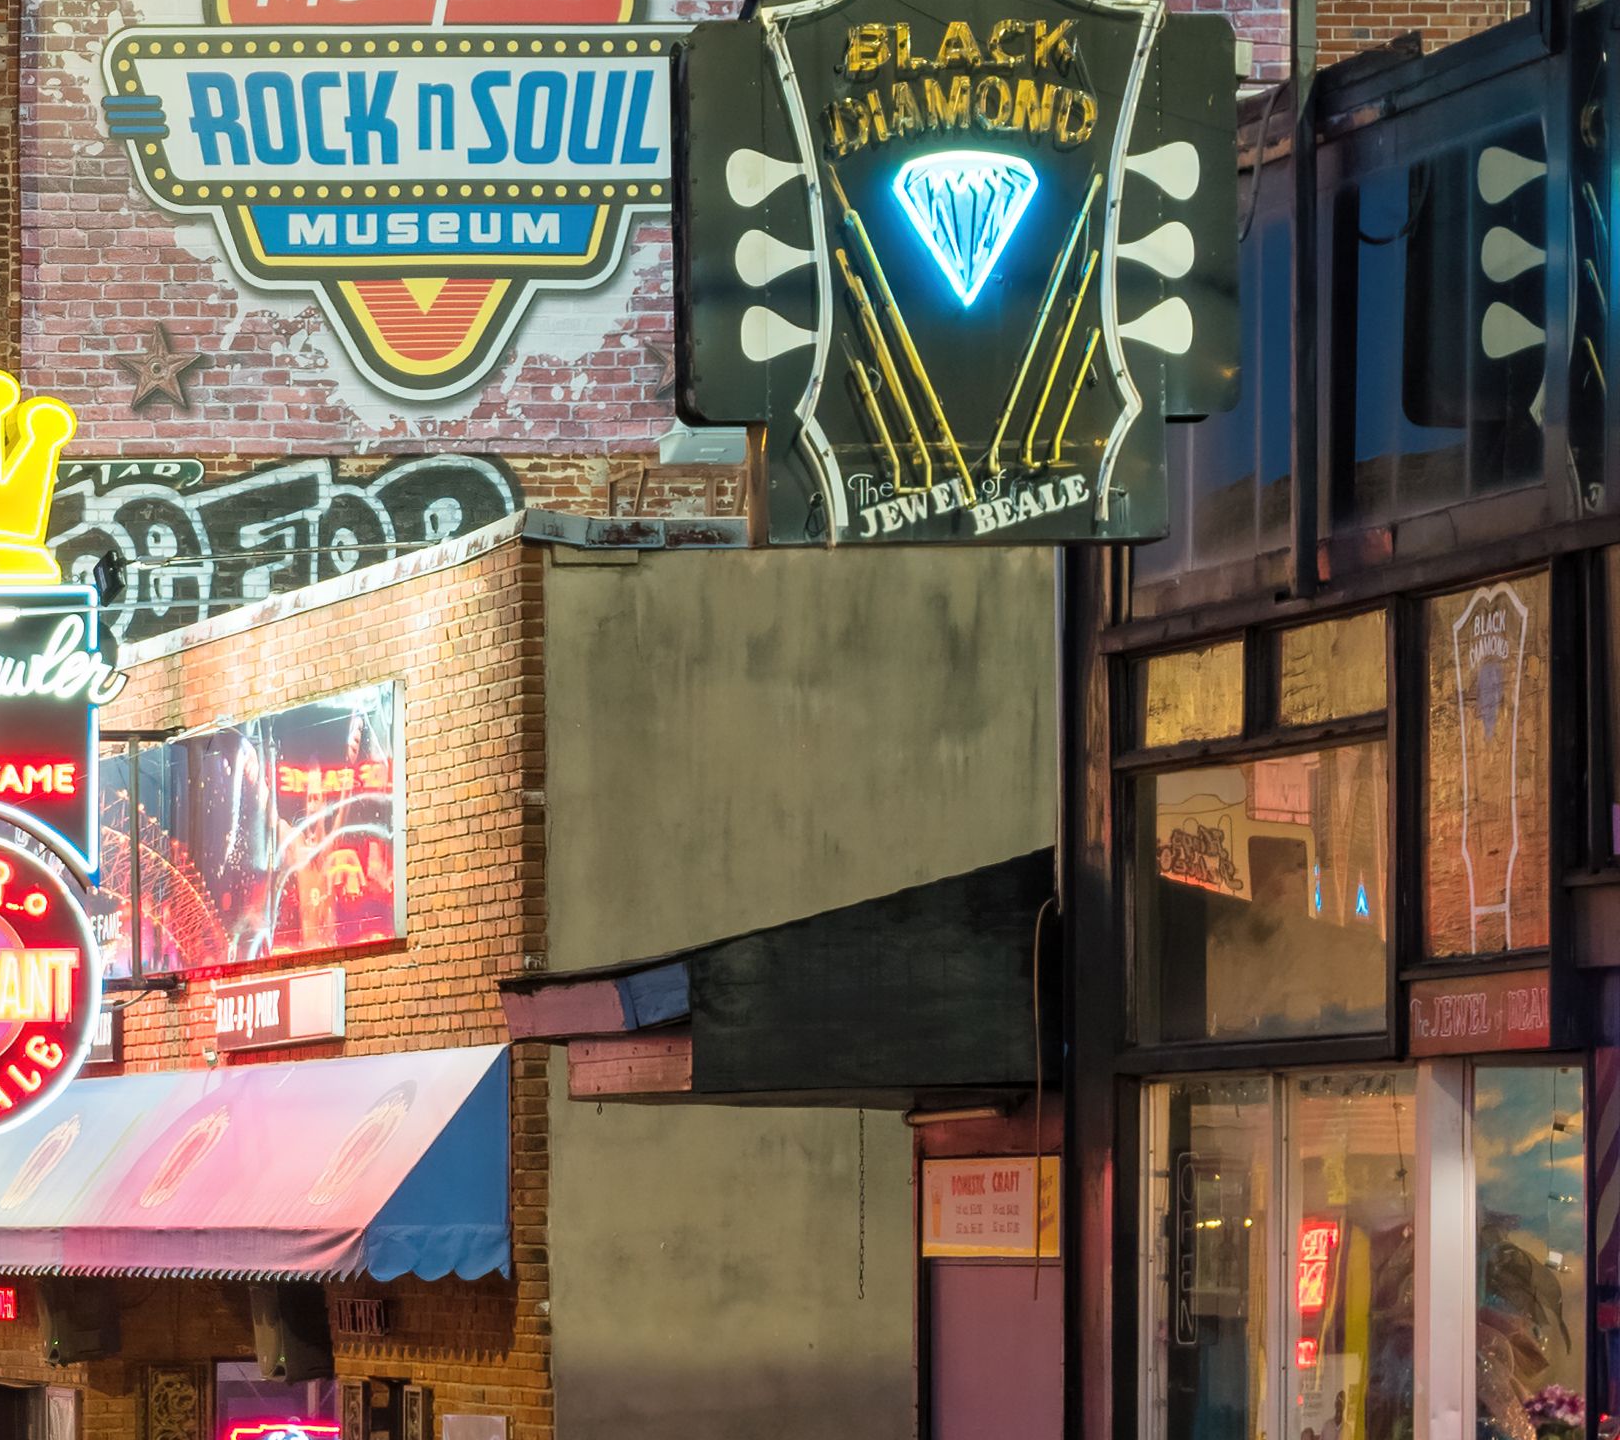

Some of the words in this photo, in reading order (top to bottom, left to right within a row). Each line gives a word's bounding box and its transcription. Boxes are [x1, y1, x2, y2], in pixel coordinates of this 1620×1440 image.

[846, 19, 1078, 75] BLACK
[189, 71, 402, 166] ROCK
[470, 69, 660, 166] SOUL
[824, 76, 1098, 154] DIAMOND
[849, 472, 895, 501] The
[859, 476, 975, 537] JEWEL
[973, 476, 1091, 535] BEALE
[983, 469, 1007, 498] of
[1474, 608, 1506, 636] BLACK
[217, 996, 254, 1039] BAR-B-Q
[255, 988, 281, 1029] PORK
[1430, 991, 1492, 1039] JEWEL
[992, 1170, 1021, 1193] CRAFT
